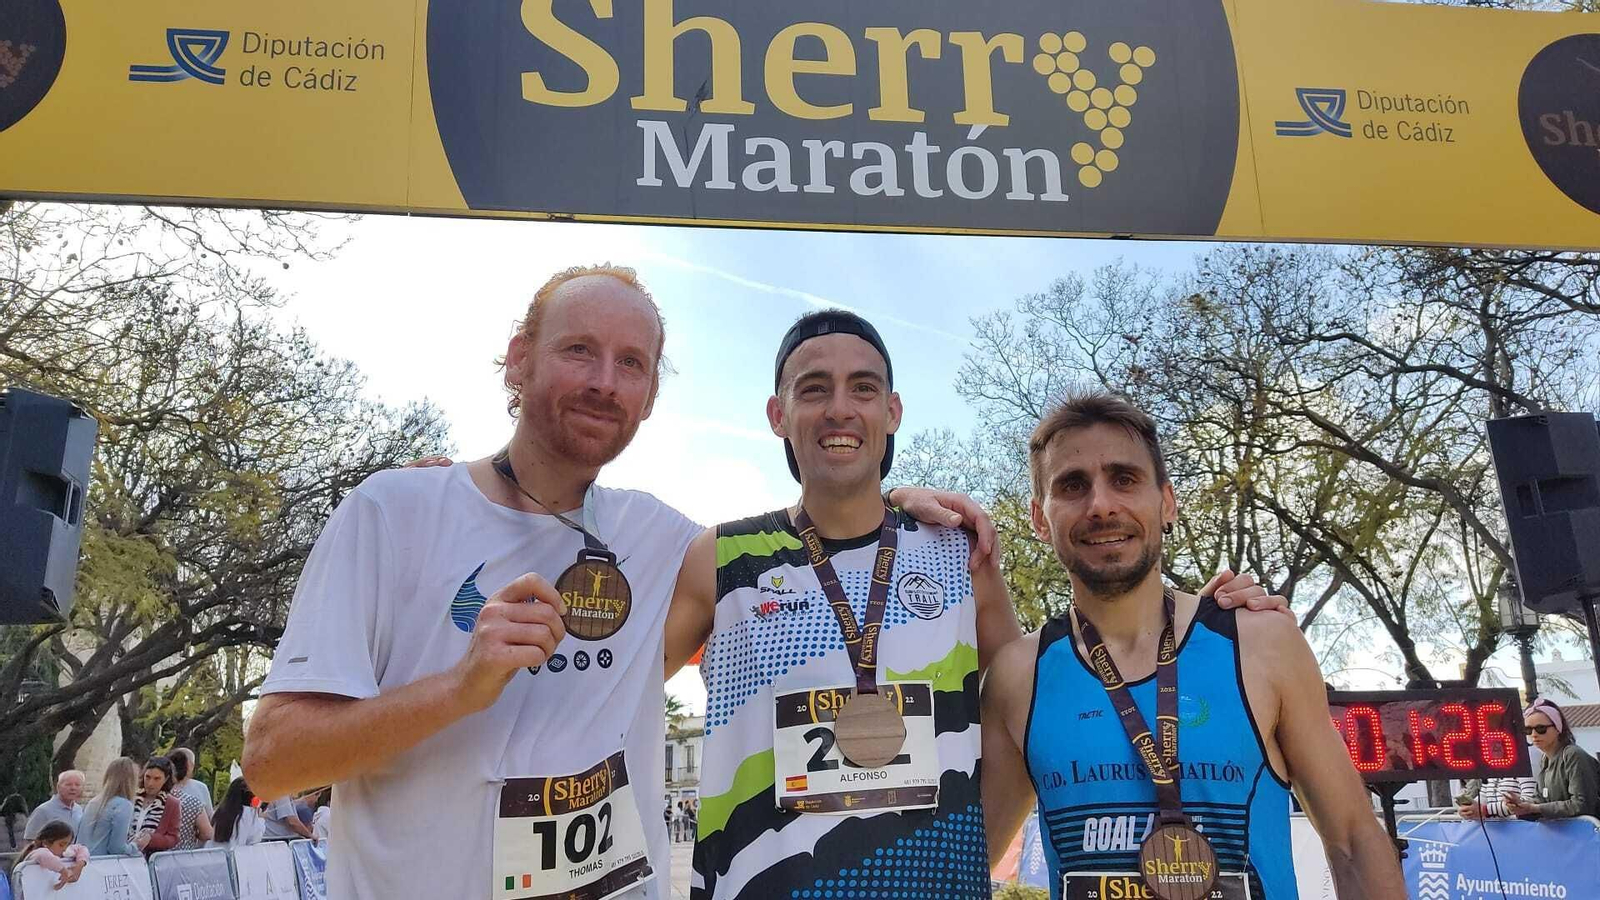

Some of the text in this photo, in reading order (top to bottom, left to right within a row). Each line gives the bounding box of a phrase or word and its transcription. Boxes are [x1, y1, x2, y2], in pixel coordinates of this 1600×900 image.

[242, 31, 386, 60] Diputación
[239, 65, 358, 92] de Cádiz
[520, 0, 1156, 188] Sherry
[1356, 89, 1470, 115] Diputación
[1362, 121, 1456, 143] de Cádiz
[1540, 110, 1600, 146] Sh
[635, 119, 1070, 202] Maratón
[562, 592, 626, 617] Sherry
[909, 594, 939, 604] TRAIL
[571, 607, 615, 619] Maratón
[1140, 738, 1166, 778] Sherry
[840, 771, 888, 782] ALFONSO
[1178, 760, 1245, 783] IATLÓN
[533, 802, 613, 870] 102
[569, 859, 603, 879] THOMAS
[1145, 858, 1212, 881] Sherry
[1158, 873, 1203, 883] Maratón
[1087, 891, 1098, 899] 20
[1110, 877, 1154, 899] She
[1211, 891, 1223, 899] 22
[1456, 873, 1567, 899] Ayuntamiento
